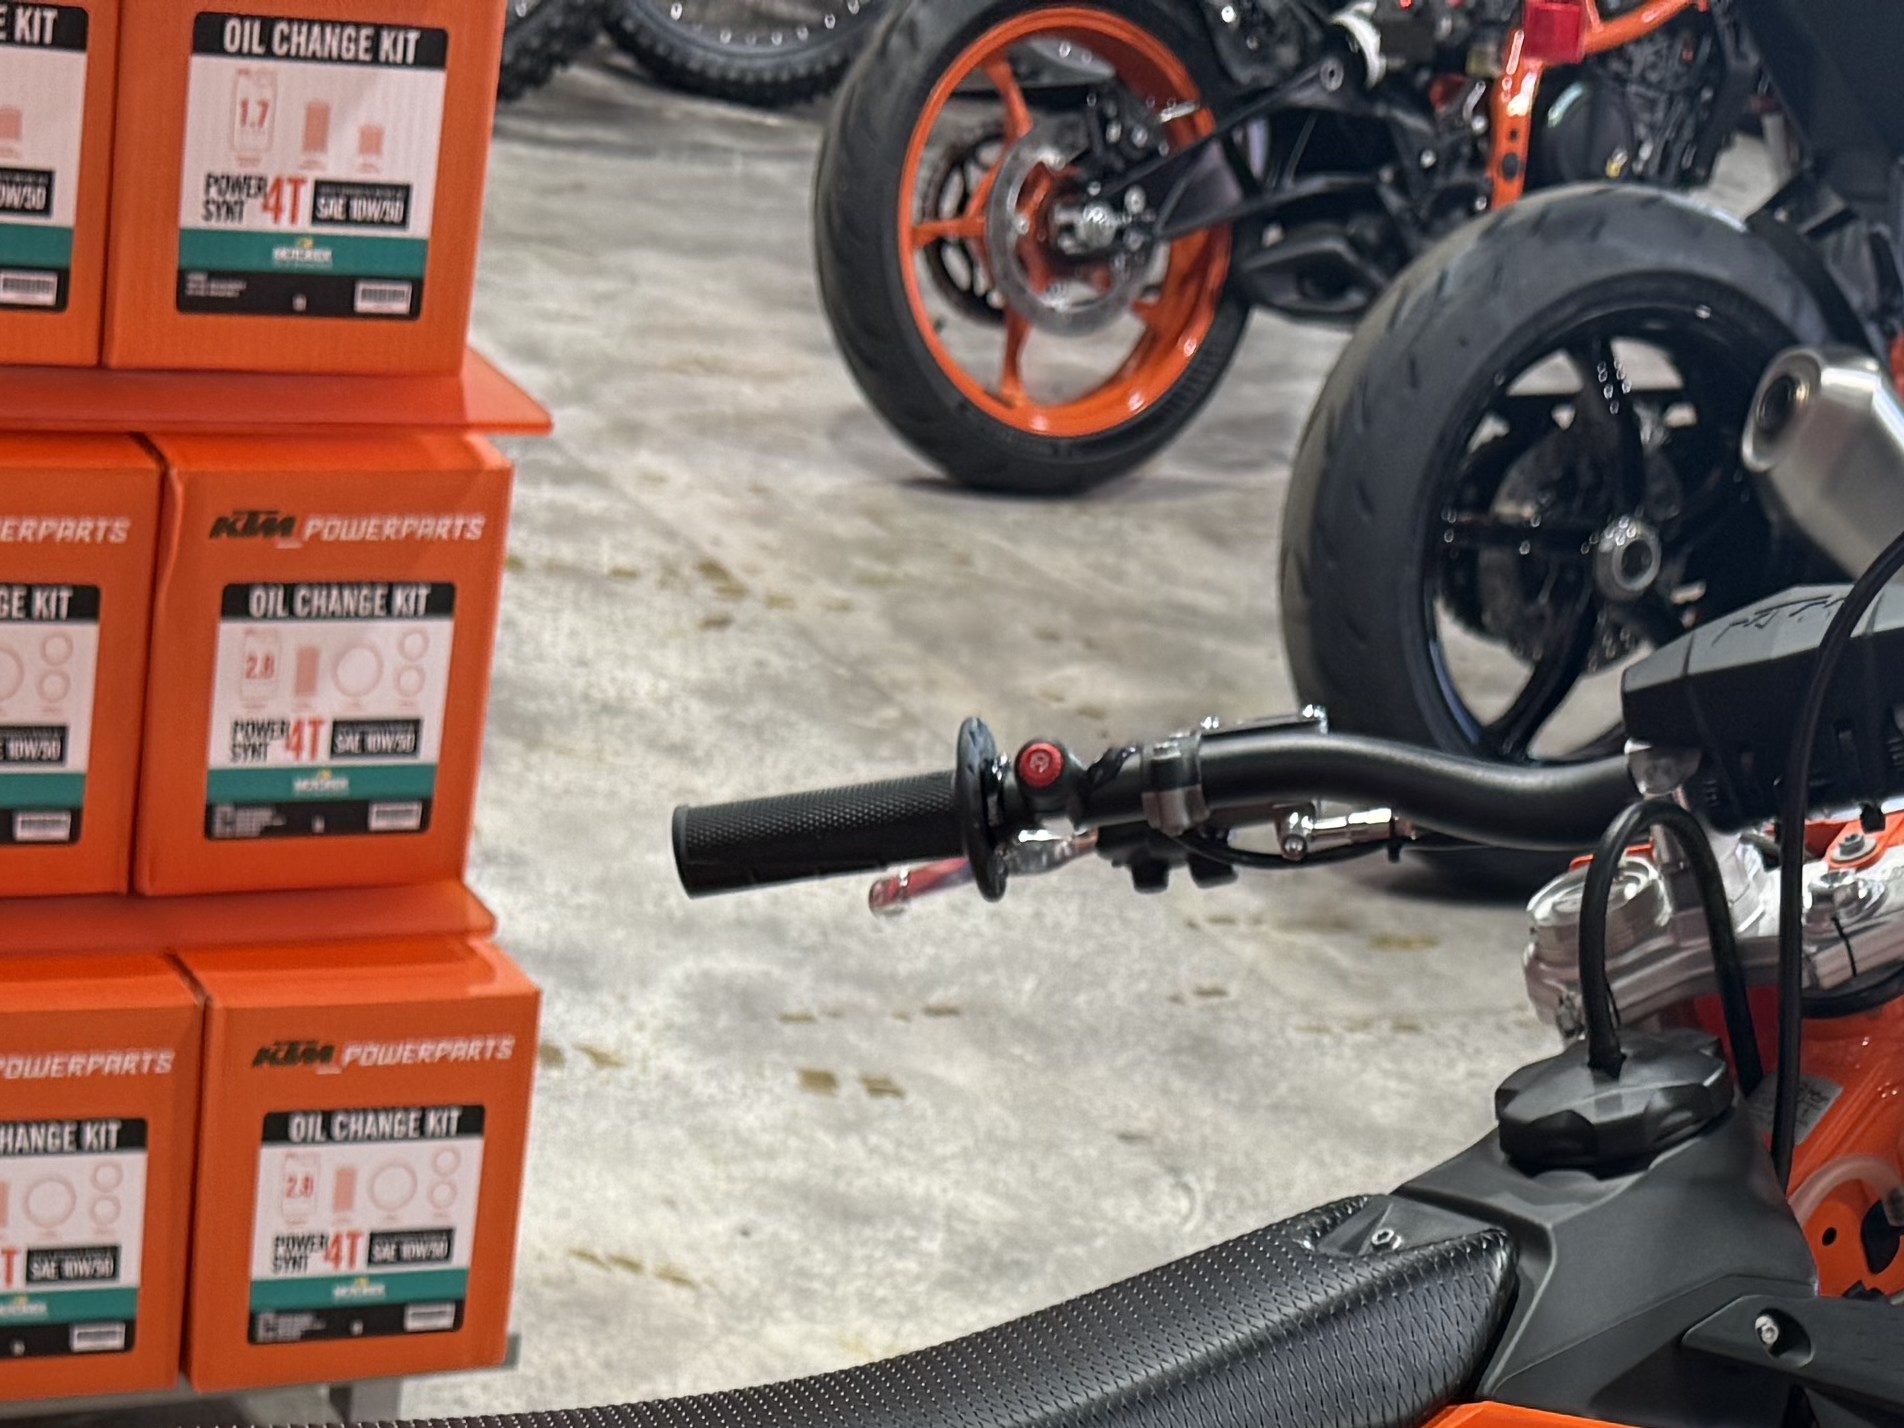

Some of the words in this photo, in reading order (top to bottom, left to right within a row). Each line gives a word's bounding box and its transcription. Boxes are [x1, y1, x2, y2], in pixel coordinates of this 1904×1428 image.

[14, 8, 58, 45] KIT
[223, 17, 266, 55] OIL
[272, 20, 374, 63] CHANGE
[379, 29, 421, 65] KIT
[239, 98, 269, 129] 1.7
[205, 172, 267, 199] POWER
[262, 176, 307, 225] 4T
[202, 198, 245, 224] SYNT
[209, 508, 298, 540] KTM
[302, 512, 487, 542] POWERPARTS
[31, 587, 73, 620] KIT
[249, 586, 289, 618] OIL
[295, 585, 388, 619] CHANGE
[391, 586, 432, 618] KIT
[232, 719, 291, 743] POWER
[286, 717, 326, 762] 4T
[342, 1035, 516, 1067] POWERPARTS
[82, 1120, 122, 1150] KIT
[289, 1112, 326, 1143] OIL
[331, 1109, 421, 1141] CHANGE
[425, 1107, 462, 1137] KIT
[324, 1231, 363, 1270] 4T
